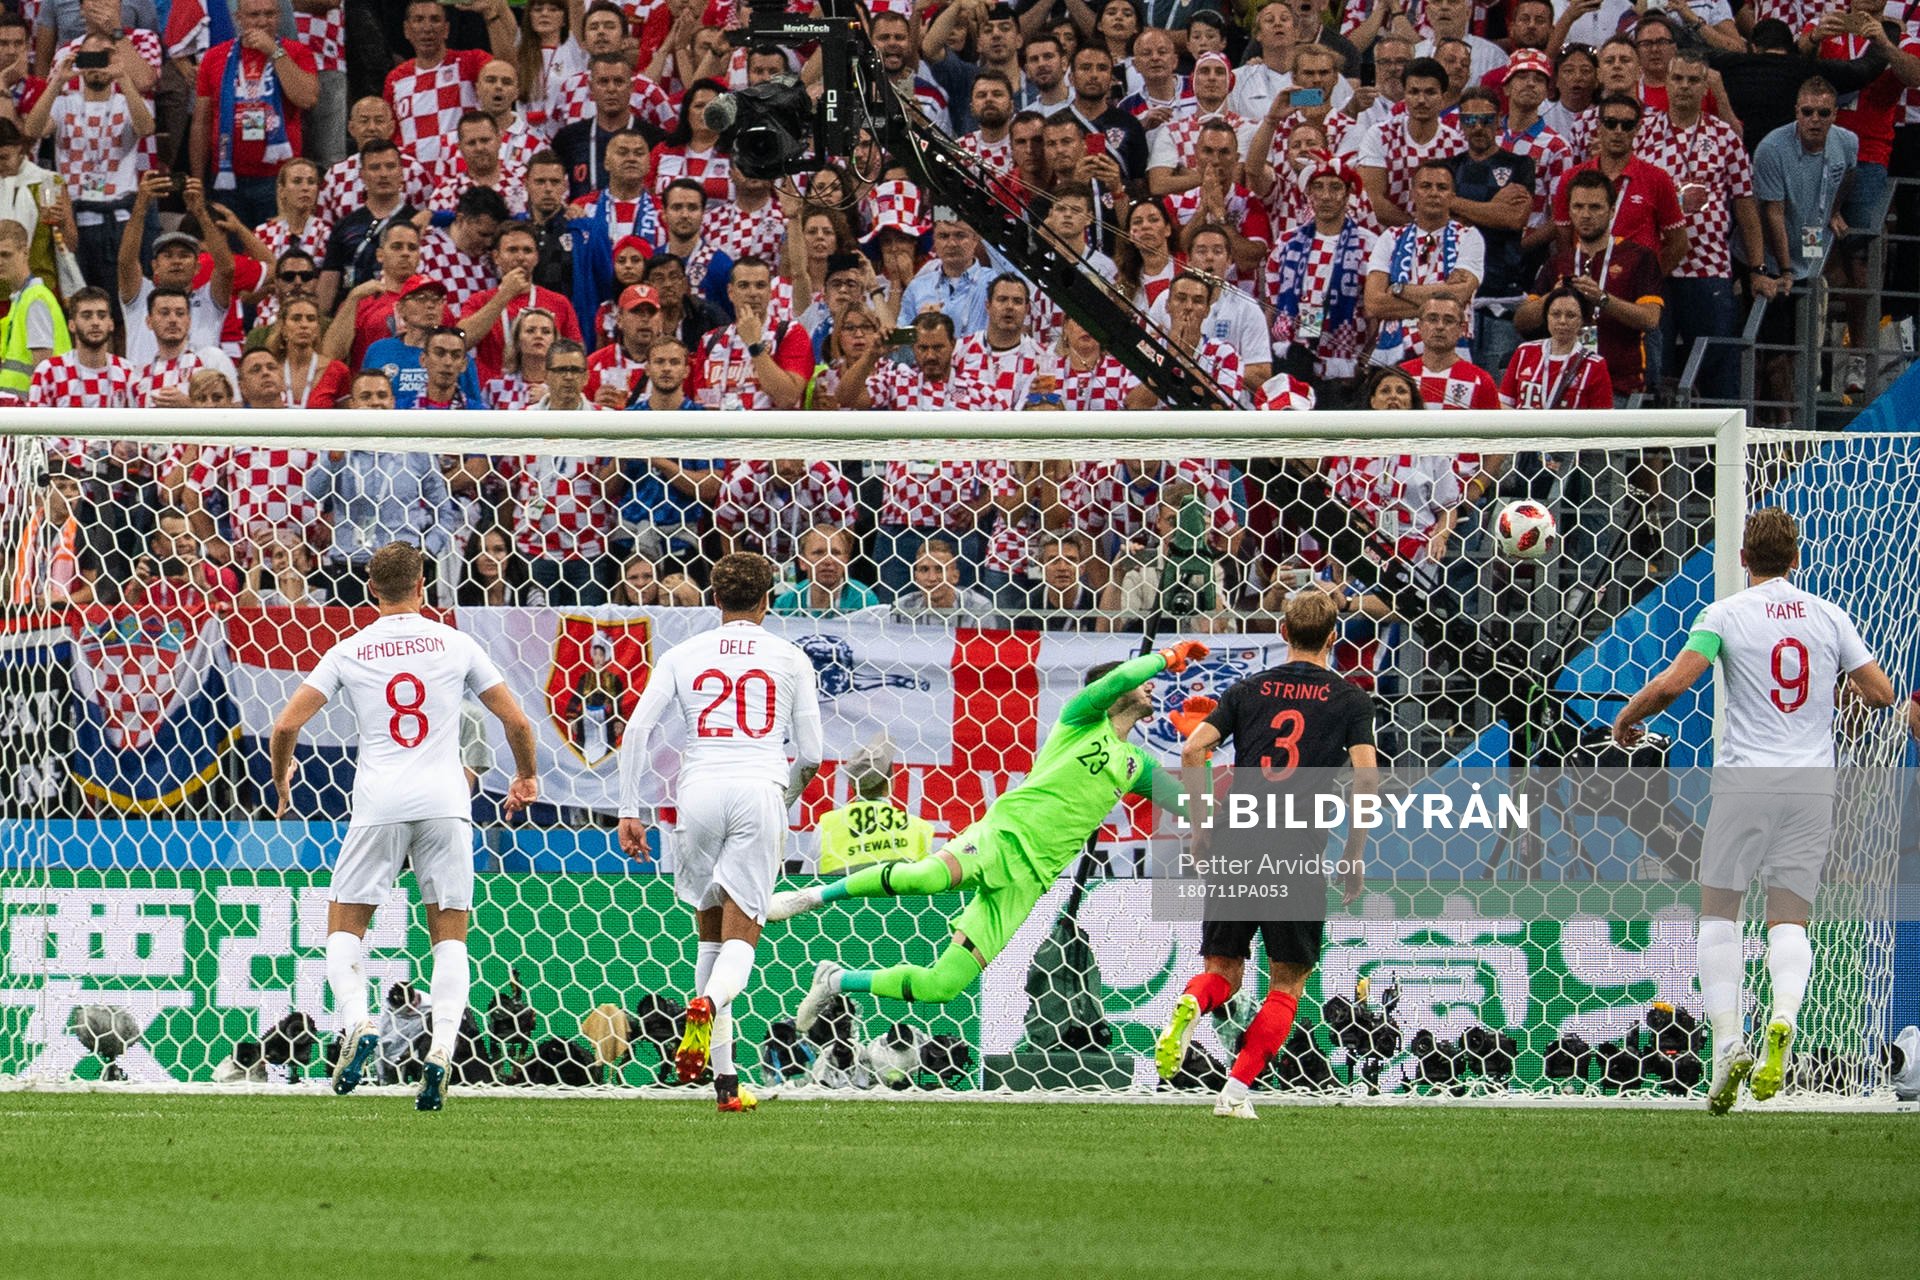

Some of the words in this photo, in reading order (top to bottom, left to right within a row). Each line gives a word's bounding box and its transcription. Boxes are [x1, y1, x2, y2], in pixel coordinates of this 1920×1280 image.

[784, 24, 830, 33] MovieTech
[1765, 601, 1807, 620] KANE
[357, 637, 446, 661] HENDERSON
[720, 639, 757, 655] DELE
[1771, 637, 1809, 713] 9
[693, 669, 776, 738] 20
[1260, 681, 1331, 702] STRINIĆ
[386, 672, 429, 748] 8
[1076, 741, 1110, 775] 23
[1260, 709, 1305, 782] 3
[849, 806, 909, 839] 3833
[848, 838, 909, 856] STEWARD
